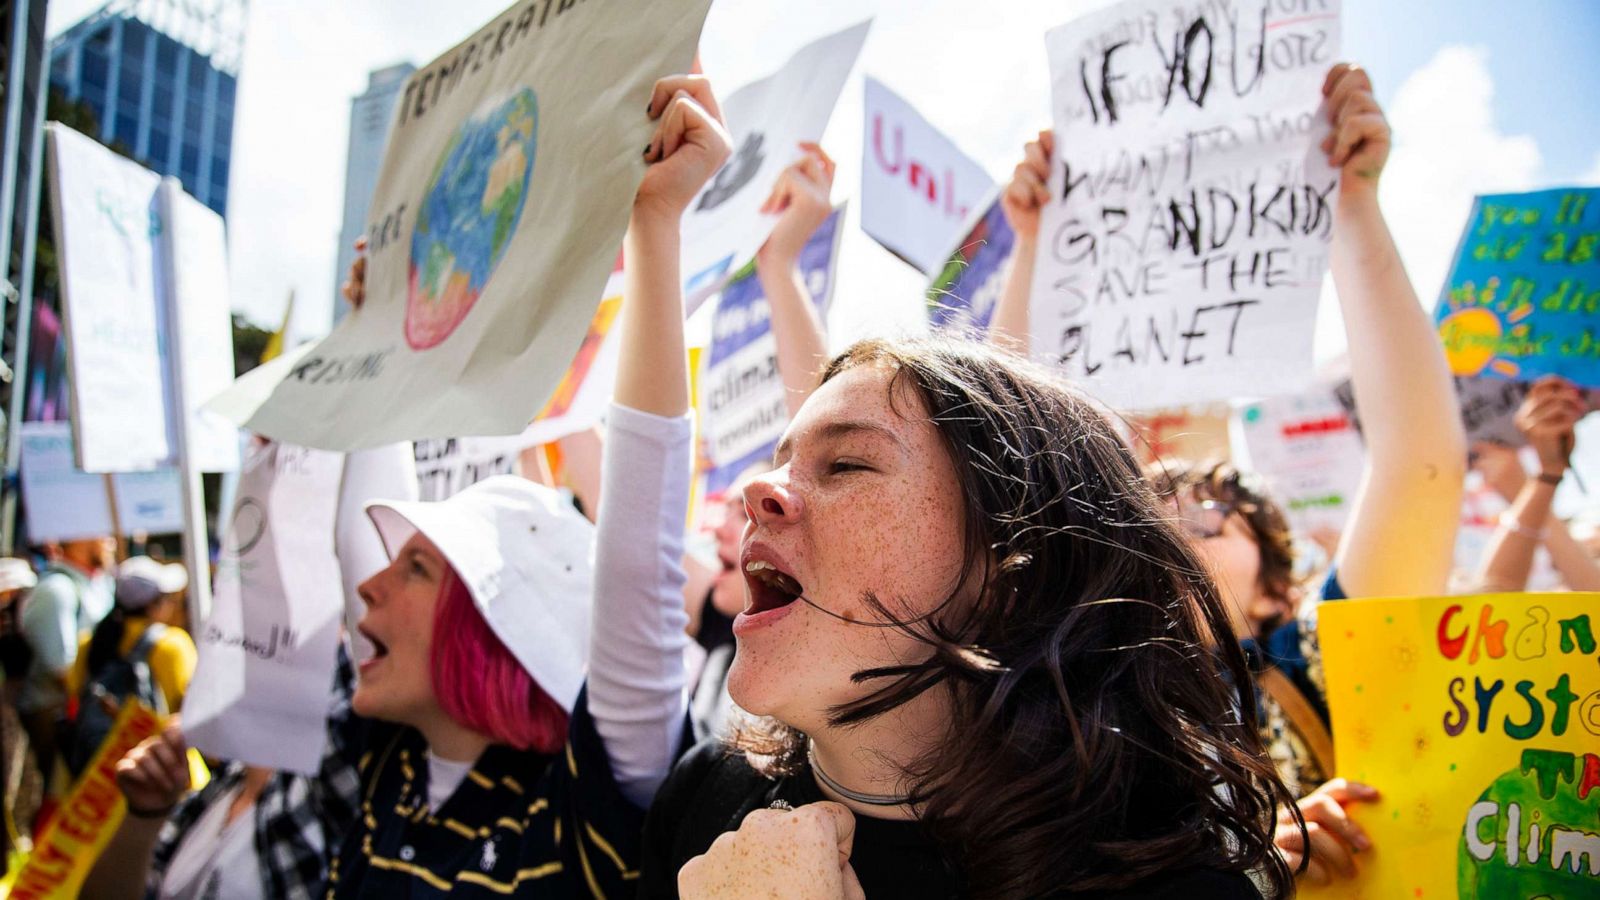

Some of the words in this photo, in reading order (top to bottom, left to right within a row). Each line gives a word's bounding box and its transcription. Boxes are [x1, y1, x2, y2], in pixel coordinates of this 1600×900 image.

[1079, 40, 1130, 126] IF
[1150, 7, 1267, 115] YOU
[1062, 125, 1231, 204] WANT
[1053, 260, 1168, 319] SAVE
[1181, 247, 1296, 294] THE
[1059, 299, 1260, 376] PLANET
[1437, 603, 1600, 665] Chan
[1466, 800, 1600, 877] Clim
